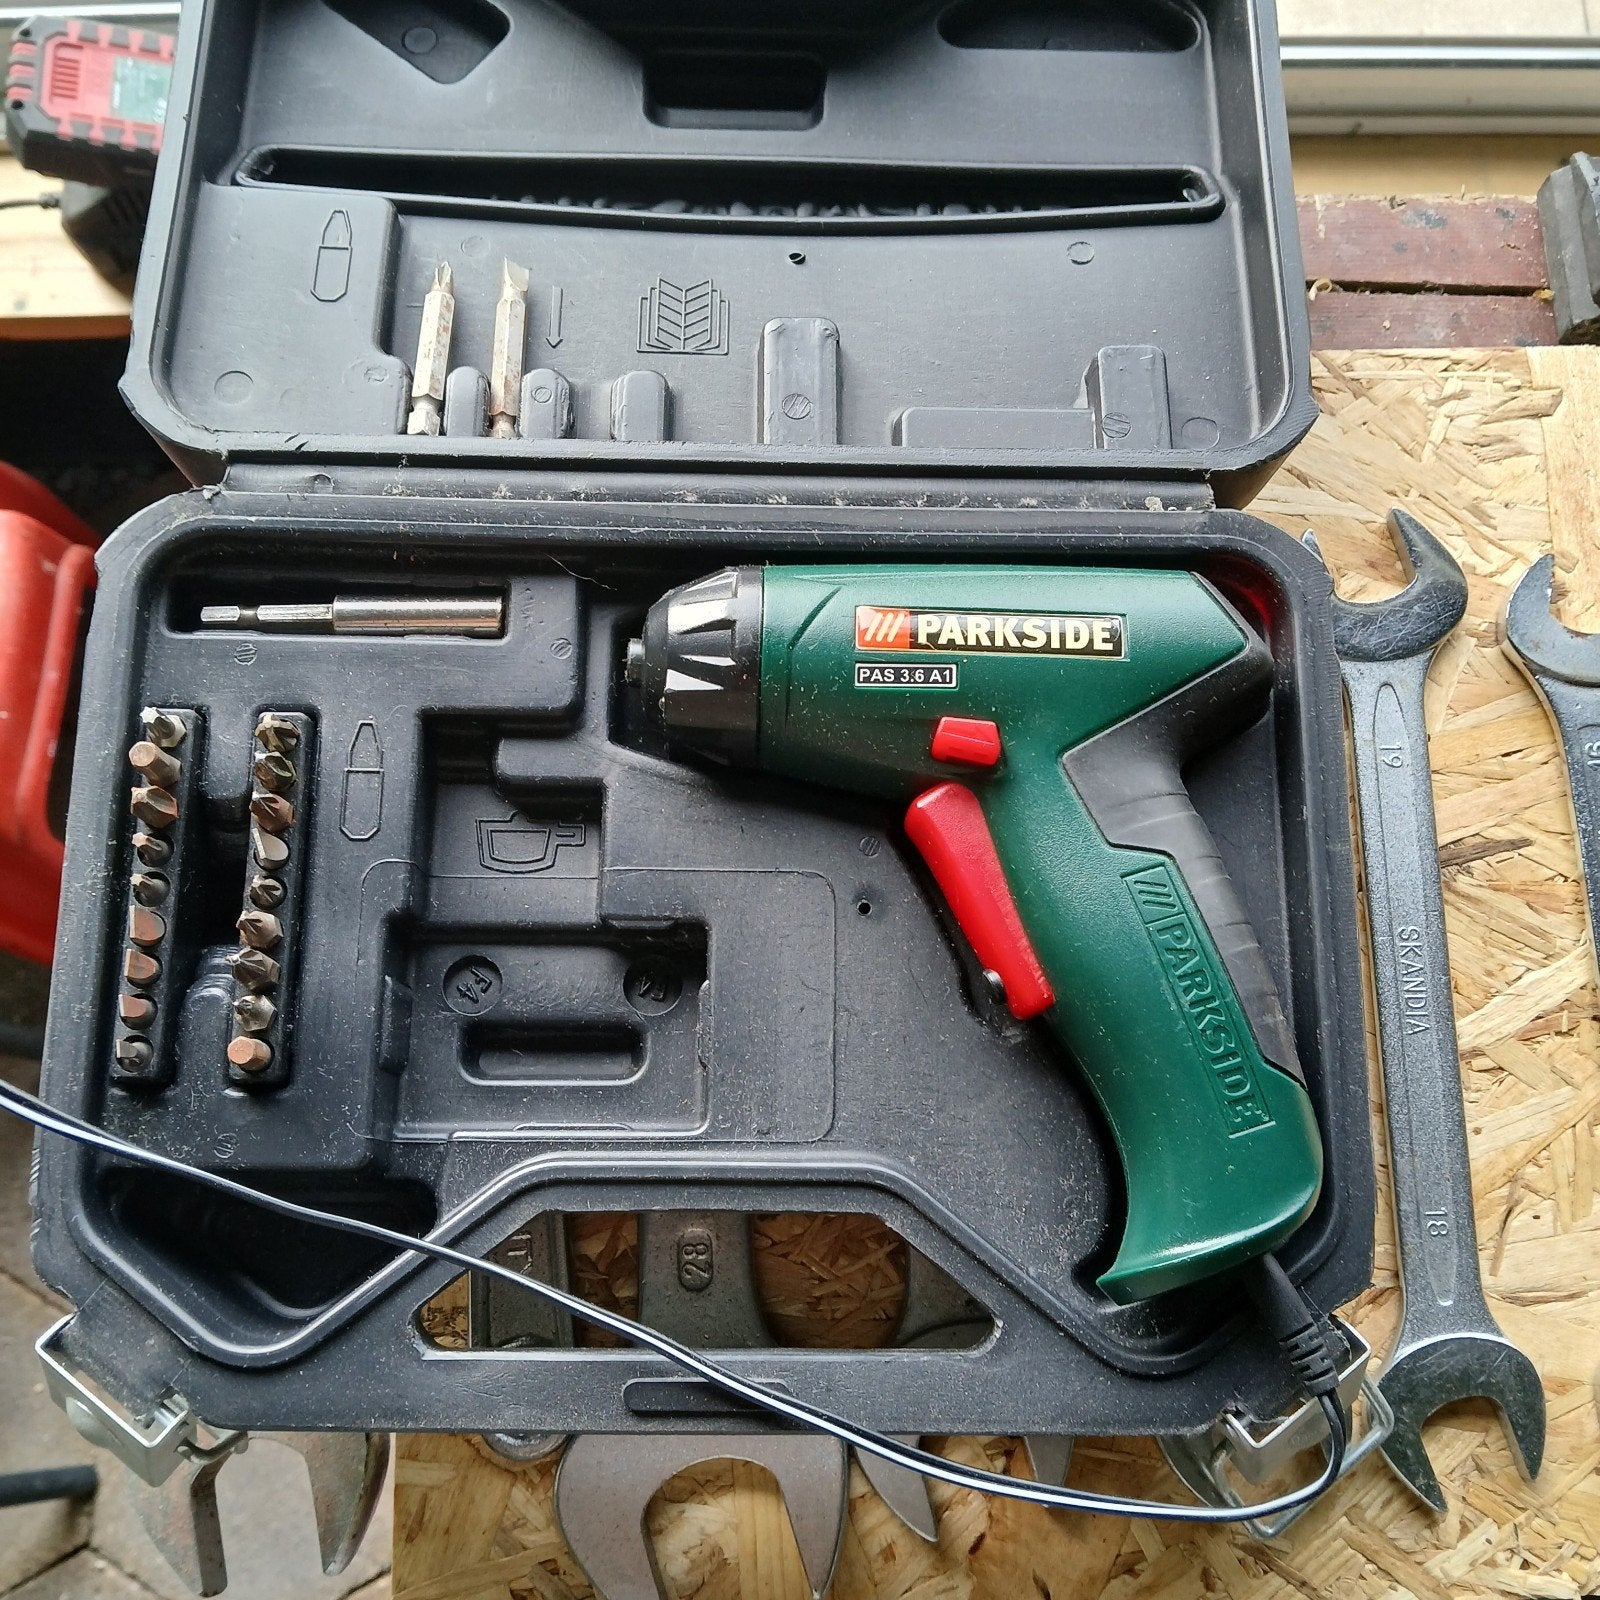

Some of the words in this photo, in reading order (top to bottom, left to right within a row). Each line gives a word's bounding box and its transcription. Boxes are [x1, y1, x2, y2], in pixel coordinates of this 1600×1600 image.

[917, 612, 1114, 651] PARKSIDE
[859, 667, 895, 683] PAS
[899, 668, 925, 683] 3.6
[929, 669, 951, 684] A1
[1379, 741, 1404, 768] 19
[1398, 924, 1431, 1036] SKANDIA
[1155, 920, 1260, 1123] PARKSIDE
[1424, 1206, 1449, 1236] 18
[681, 1242, 710, 1279] 28
